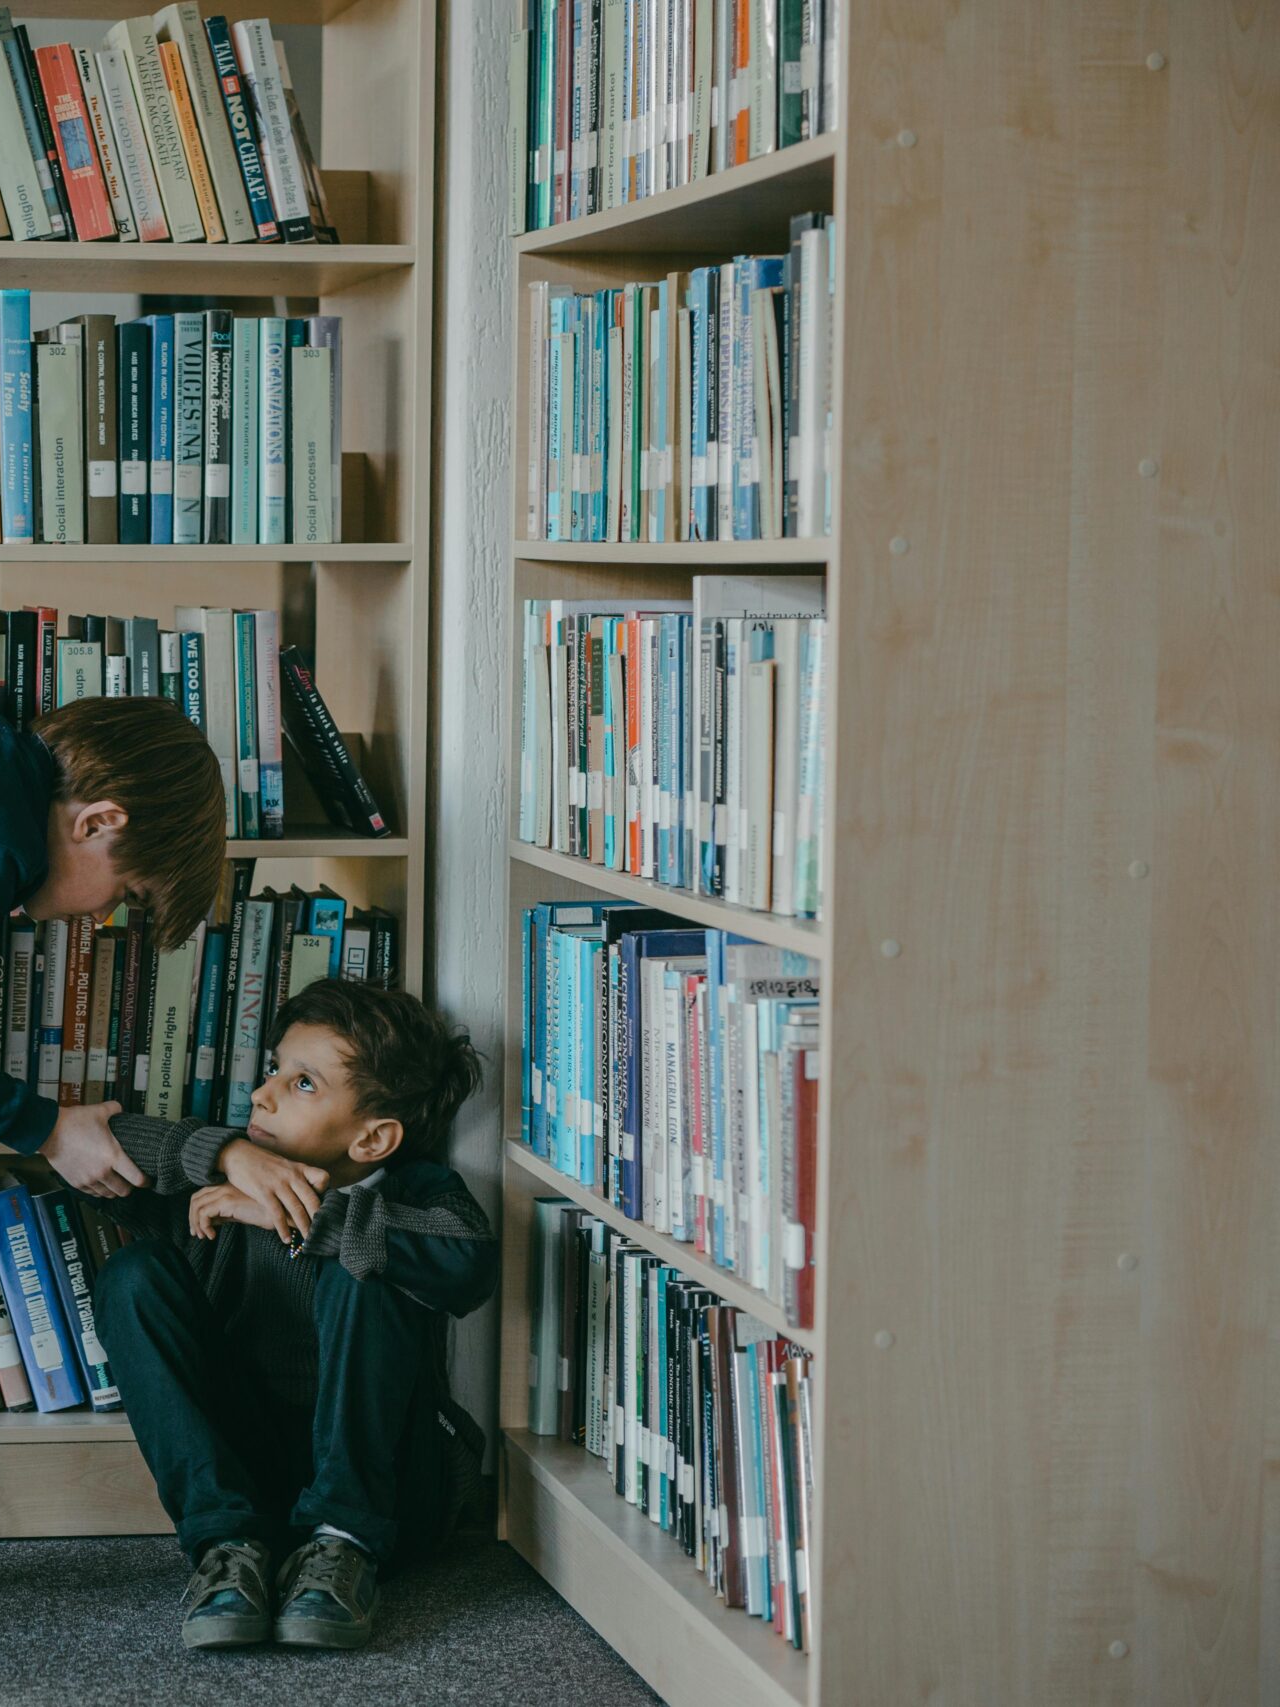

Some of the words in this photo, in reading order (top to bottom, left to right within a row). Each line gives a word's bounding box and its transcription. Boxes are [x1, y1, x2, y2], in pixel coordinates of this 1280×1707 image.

[143, 35, 159, 57] NIV
[214, 40, 238, 74] TALK
[149, 60, 167, 93] BIBLE
[136, 55, 157, 103] ALISTER
[148, 106, 171, 166] MCGRATH
[227, 96, 250, 141] NOT
[157, 96, 188, 182] COMMENTARY
[238, 143, 267, 202] CHEAP!
[16, 186, 36, 238] Religion
[50, 347, 66, 355] 302
[304, 350, 320, 358] 303
[5, 373, 15, 383] in
[183, 340, 201, 420] VOICES
[210, 351, 220, 395] without
[221, 351, 231, 418] Technologies
[5, 387, 15, 417] Focus
[18, 372, 29, 411] Society
[267, 345, 282, 462] ORGANIZATIONS
[210, 400, 220, 459] Boundaries
[56, 438, 65, 501] interaction
[307, 441, 317, 502] processes
[57, 505, 66, 540] Social
[308, 506, 317, 540] Social
[188, 639, 198, 658] WE
[188, 661, 198, 689] TOO
[294, 665, 312, 691] Love
[309, 694, 317, 703] in
[315, 705, 331, 729] black
[333, 741, 348, 764] white
[232, 902, 243, 930] MARTIN
[80, 916, 91, 953] WOMEN
[230, 933, 240, 958] LUTHER
[303, 938, 320, 947] 324
[48, 952, 58, 988] AMERICA
[12, 951, 29, 1032] LIBERTARIANISM
[47, 991, 56, 1018] RIGHT
[76, 973, 88, 1016] POLITICS
[241, 973, 262, 1030] KING
[165, 1007, 176, 1040] rights
[161, 1042, 172, 1087] political
[667, 1042, 678, 1114] MANAGERIAL
[159, 1093, 169, 1101] &
[61, 1238, 83, 1261] The
[67, 1263, 91, 1295] Great
